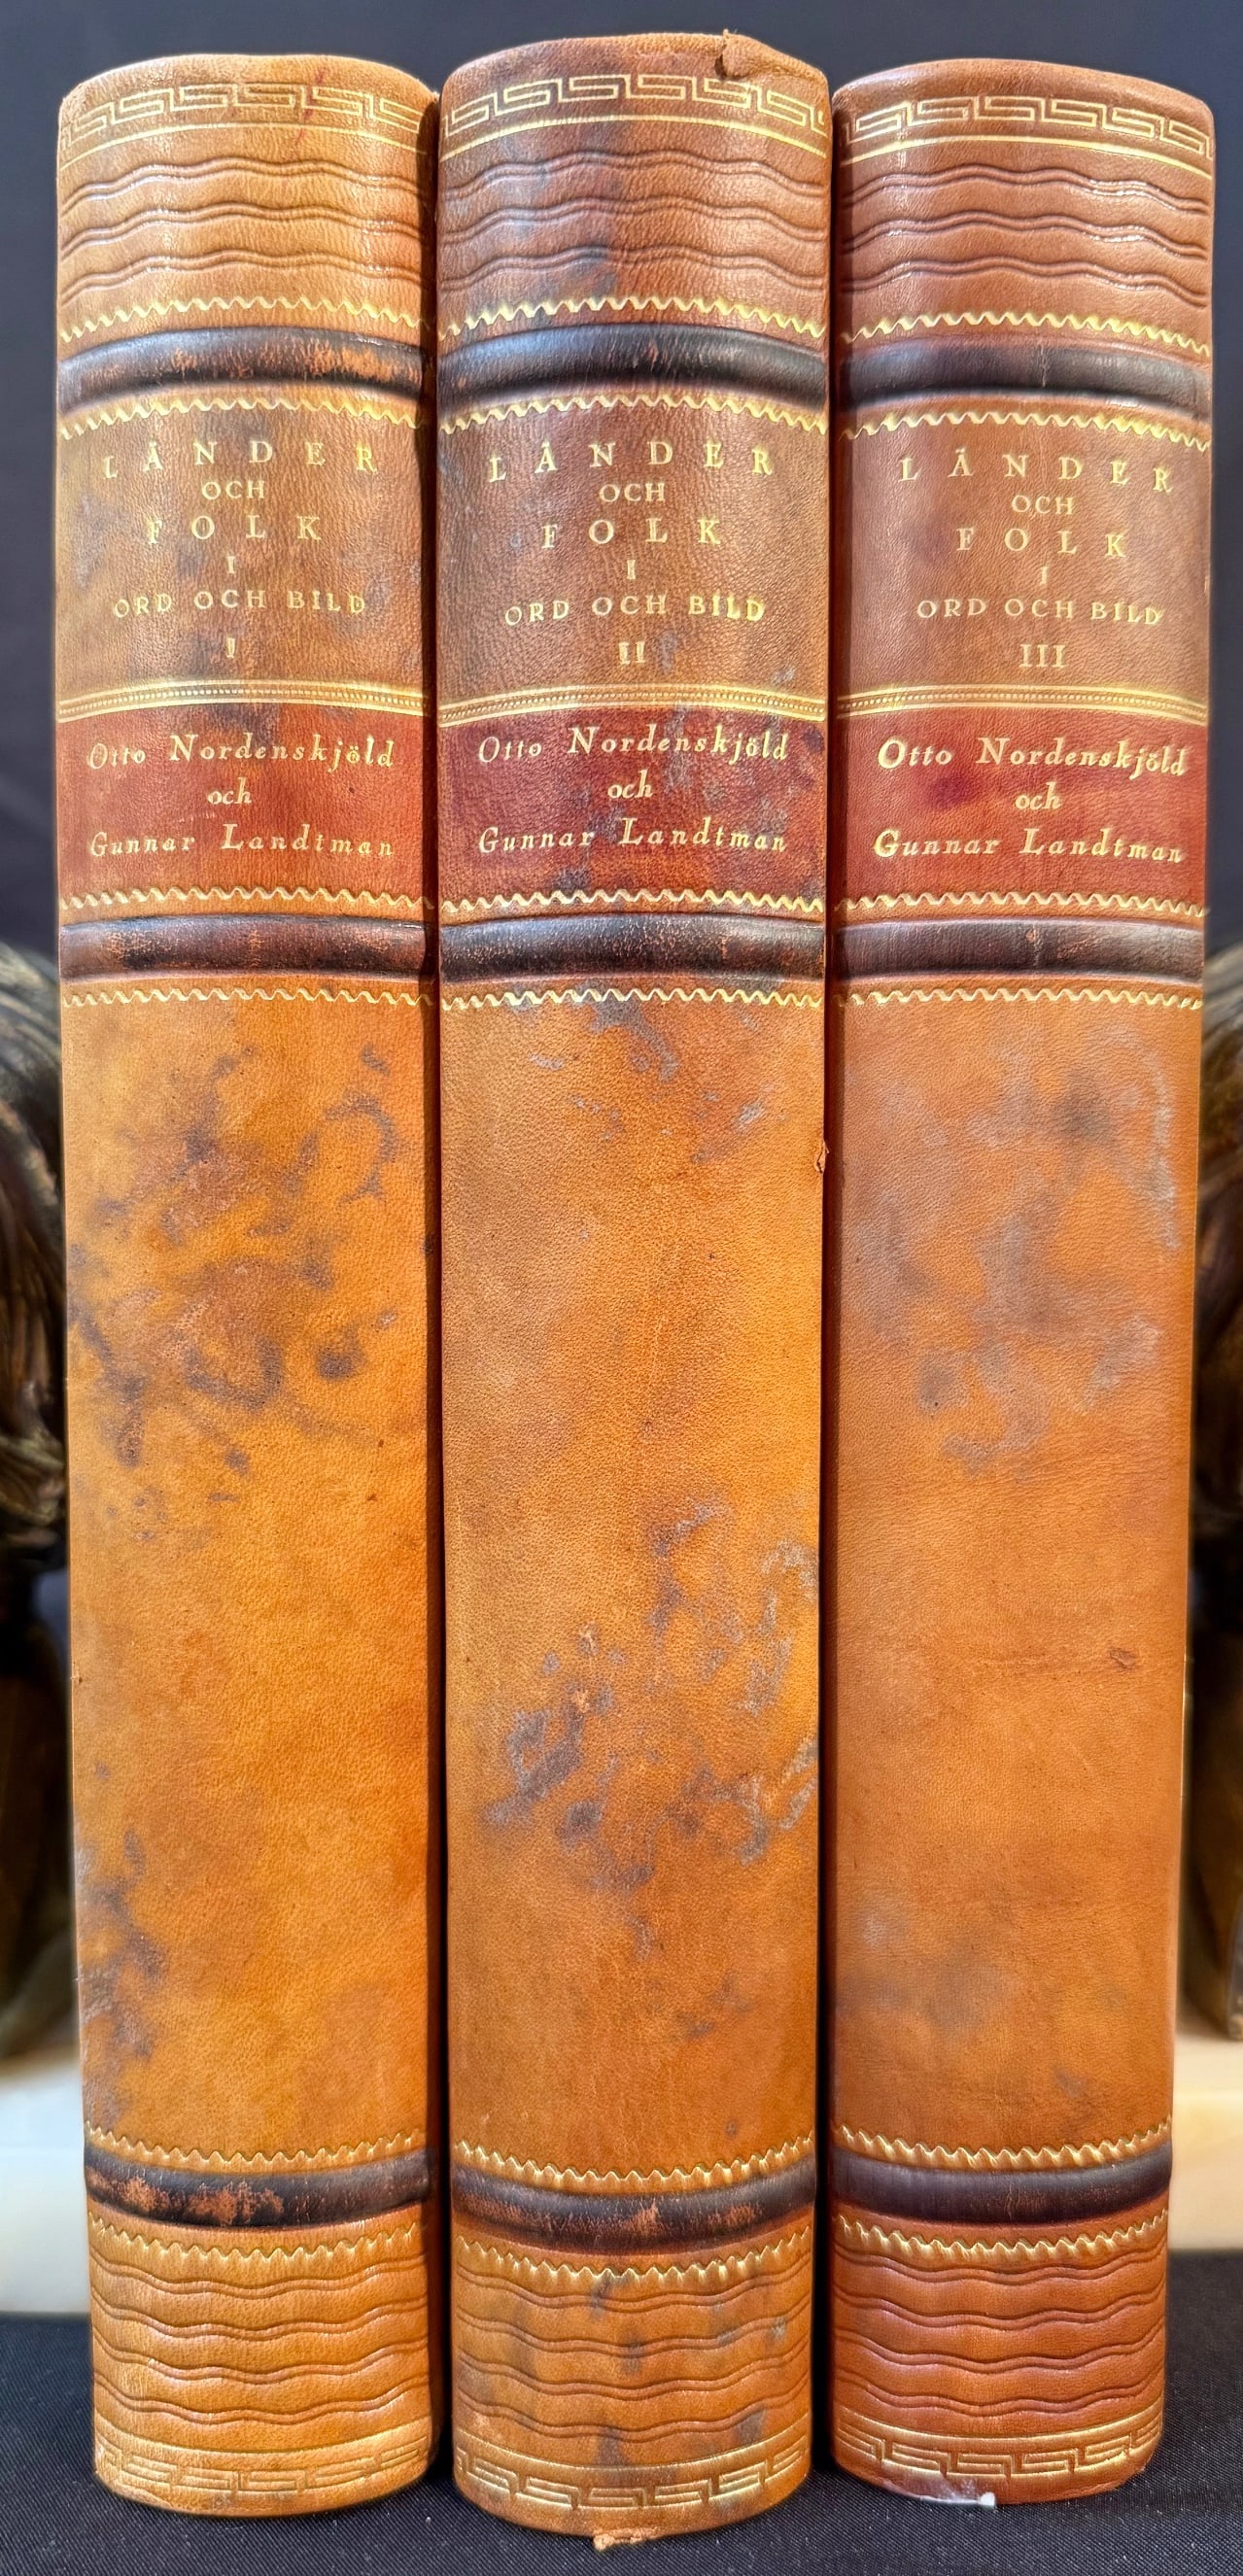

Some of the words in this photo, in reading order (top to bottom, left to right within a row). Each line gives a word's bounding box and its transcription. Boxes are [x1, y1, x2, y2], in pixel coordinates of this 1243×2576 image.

[898, 448, 1173, 494] LÄNDER
[201, 480, 265, 500] OCH
[599, 482, 665, 502] OCH
[1012, 495, 1074, 515] OCH
[147, 515, 322, 544] FOLK
[540, 517, 721, 548] FOLK
[956, 528, 1128, 558] FOLK
[114, 593, 173, 618] ORD
[193, 589, 266, 609] OCH
[287, 591, 365, 615] BILD
[504, 600, 570, 626] ORD
[592, 595, 668, 616] OCH
[688, 591, 765, 622] BILD
[917, 598, 988, 618] ORD
[1005, 599, 1074, 618] OCH
[1090, 601, 1164, 626] BILD
[618, 641, 645, 666] II
[1019, 643, 1067, 669] III
[87, 743, 146, 770] Otto
[169, 733, 395, 773] Nordenskjöld
[478, 737, 542, 763] Otto
[569, 724, 789, 765] Nordenskjöld
[878, 738, 952, 770] Otto
[976, 738, 1189, 779] Nordenskjöld
[207, 778, 253, 806] och
[607, 770, 653, 799] och
[1015, 782, 1061, 809] och
[90, 833, 195, 858] Gunnar
[220, 823, 395, 857] Landtman
[479, 827, 596, 853] Gunnar
[619, 817, 785, 852] Landtman
[875, 829, 1000, 858] Gunnar
[1019, 828, 1183, 864] Landtman
